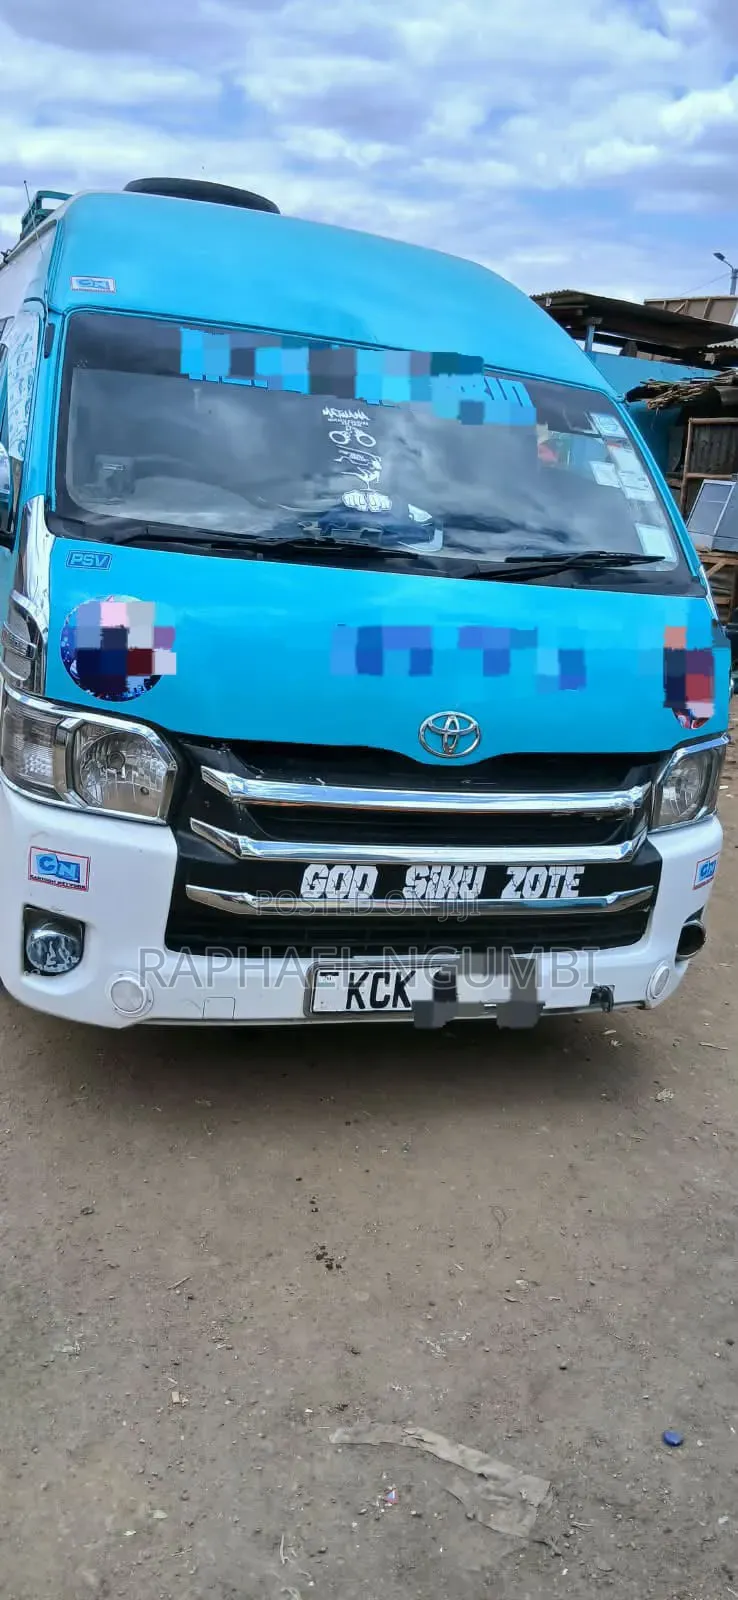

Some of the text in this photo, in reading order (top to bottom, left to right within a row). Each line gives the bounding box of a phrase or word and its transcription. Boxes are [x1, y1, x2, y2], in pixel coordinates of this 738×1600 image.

[70, 553, 109, 567] PSV
[301, 863, 585, 899] GOD SIKU ZOTE
[346, 971, 416, 1009] KCK
